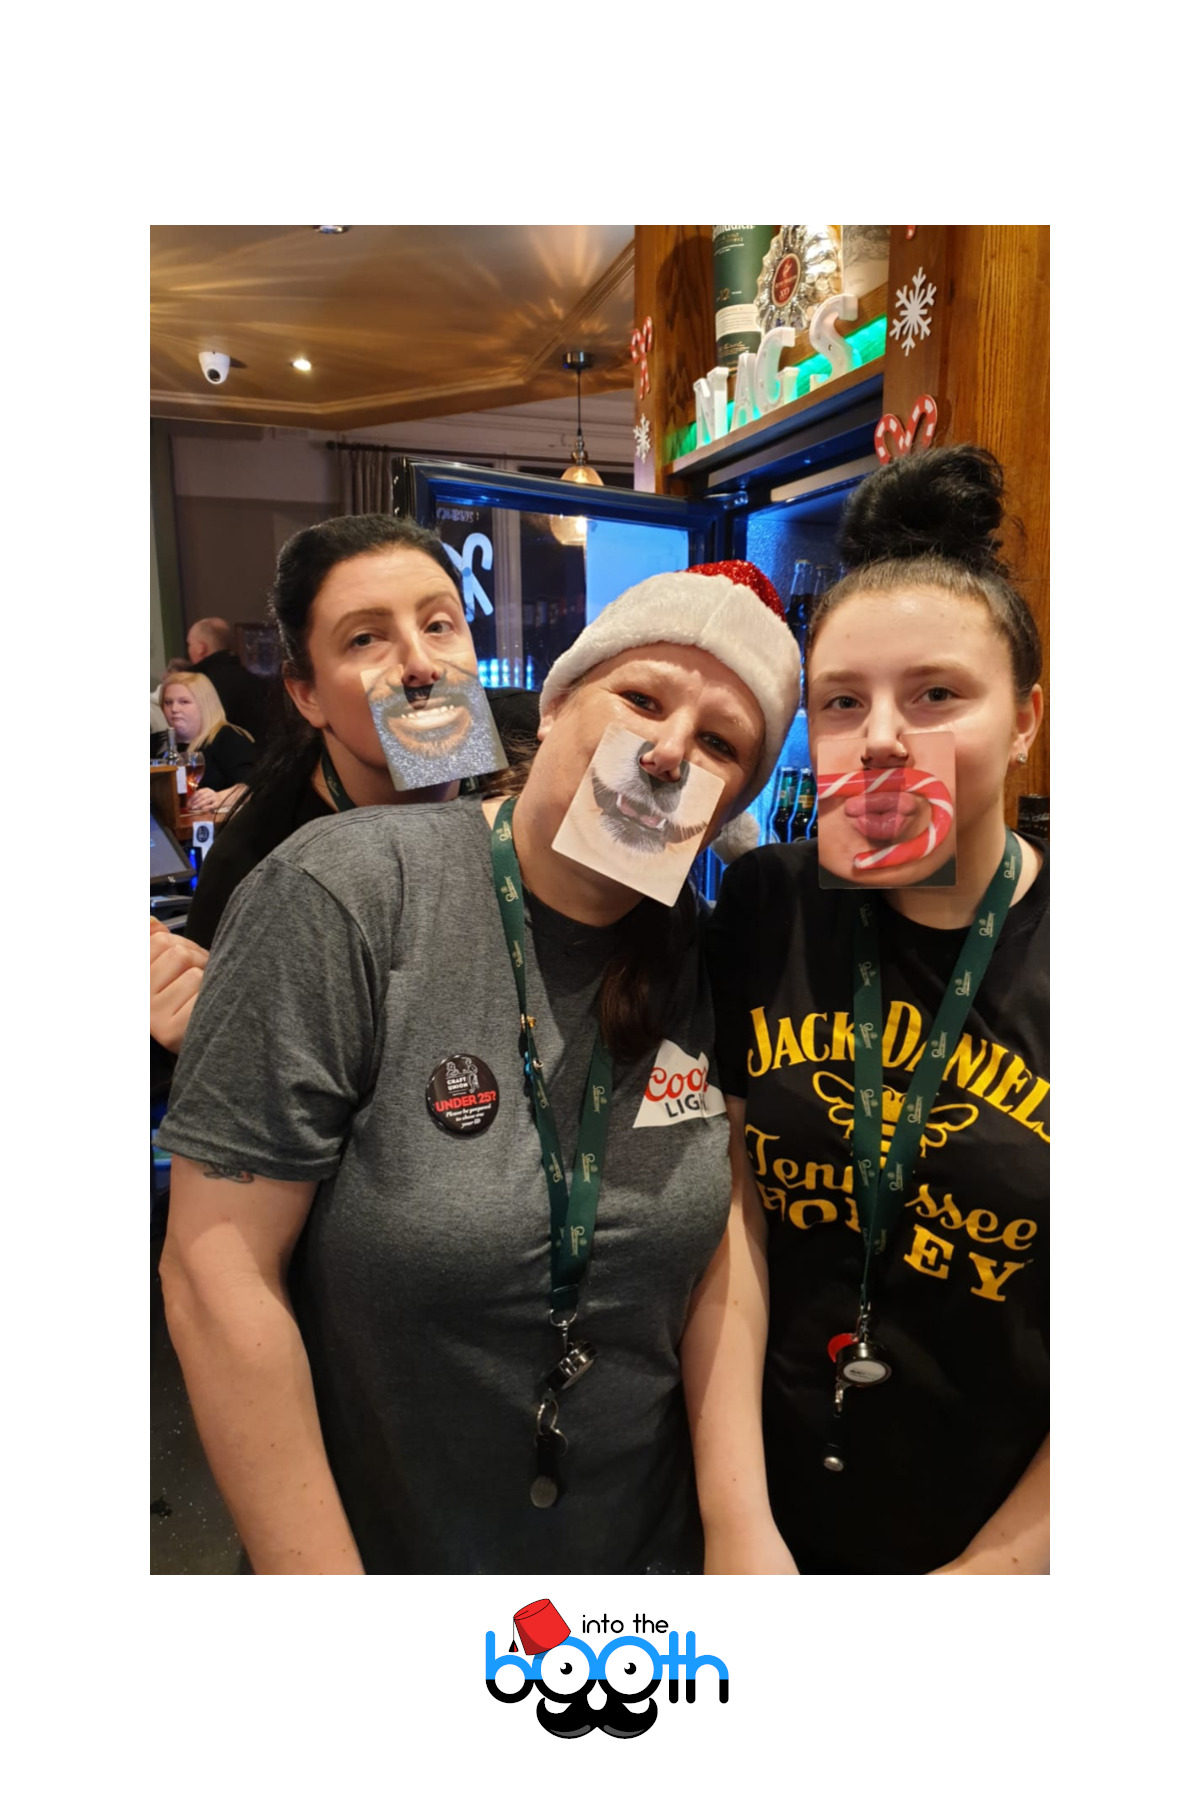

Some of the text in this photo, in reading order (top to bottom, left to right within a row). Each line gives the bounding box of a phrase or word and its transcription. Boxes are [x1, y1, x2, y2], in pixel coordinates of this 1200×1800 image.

[693, 293, 860, 449] NAGS
[434, 1090, 497, 1112] UNDER 25?
[645, 1066, 709, 1102] Coo
[665, 1094, 707, 1118] LIG
[747, 1000, 1050, 1144] JACK DNIEL
[745, 1124, 1038, 1250] Tenssee
